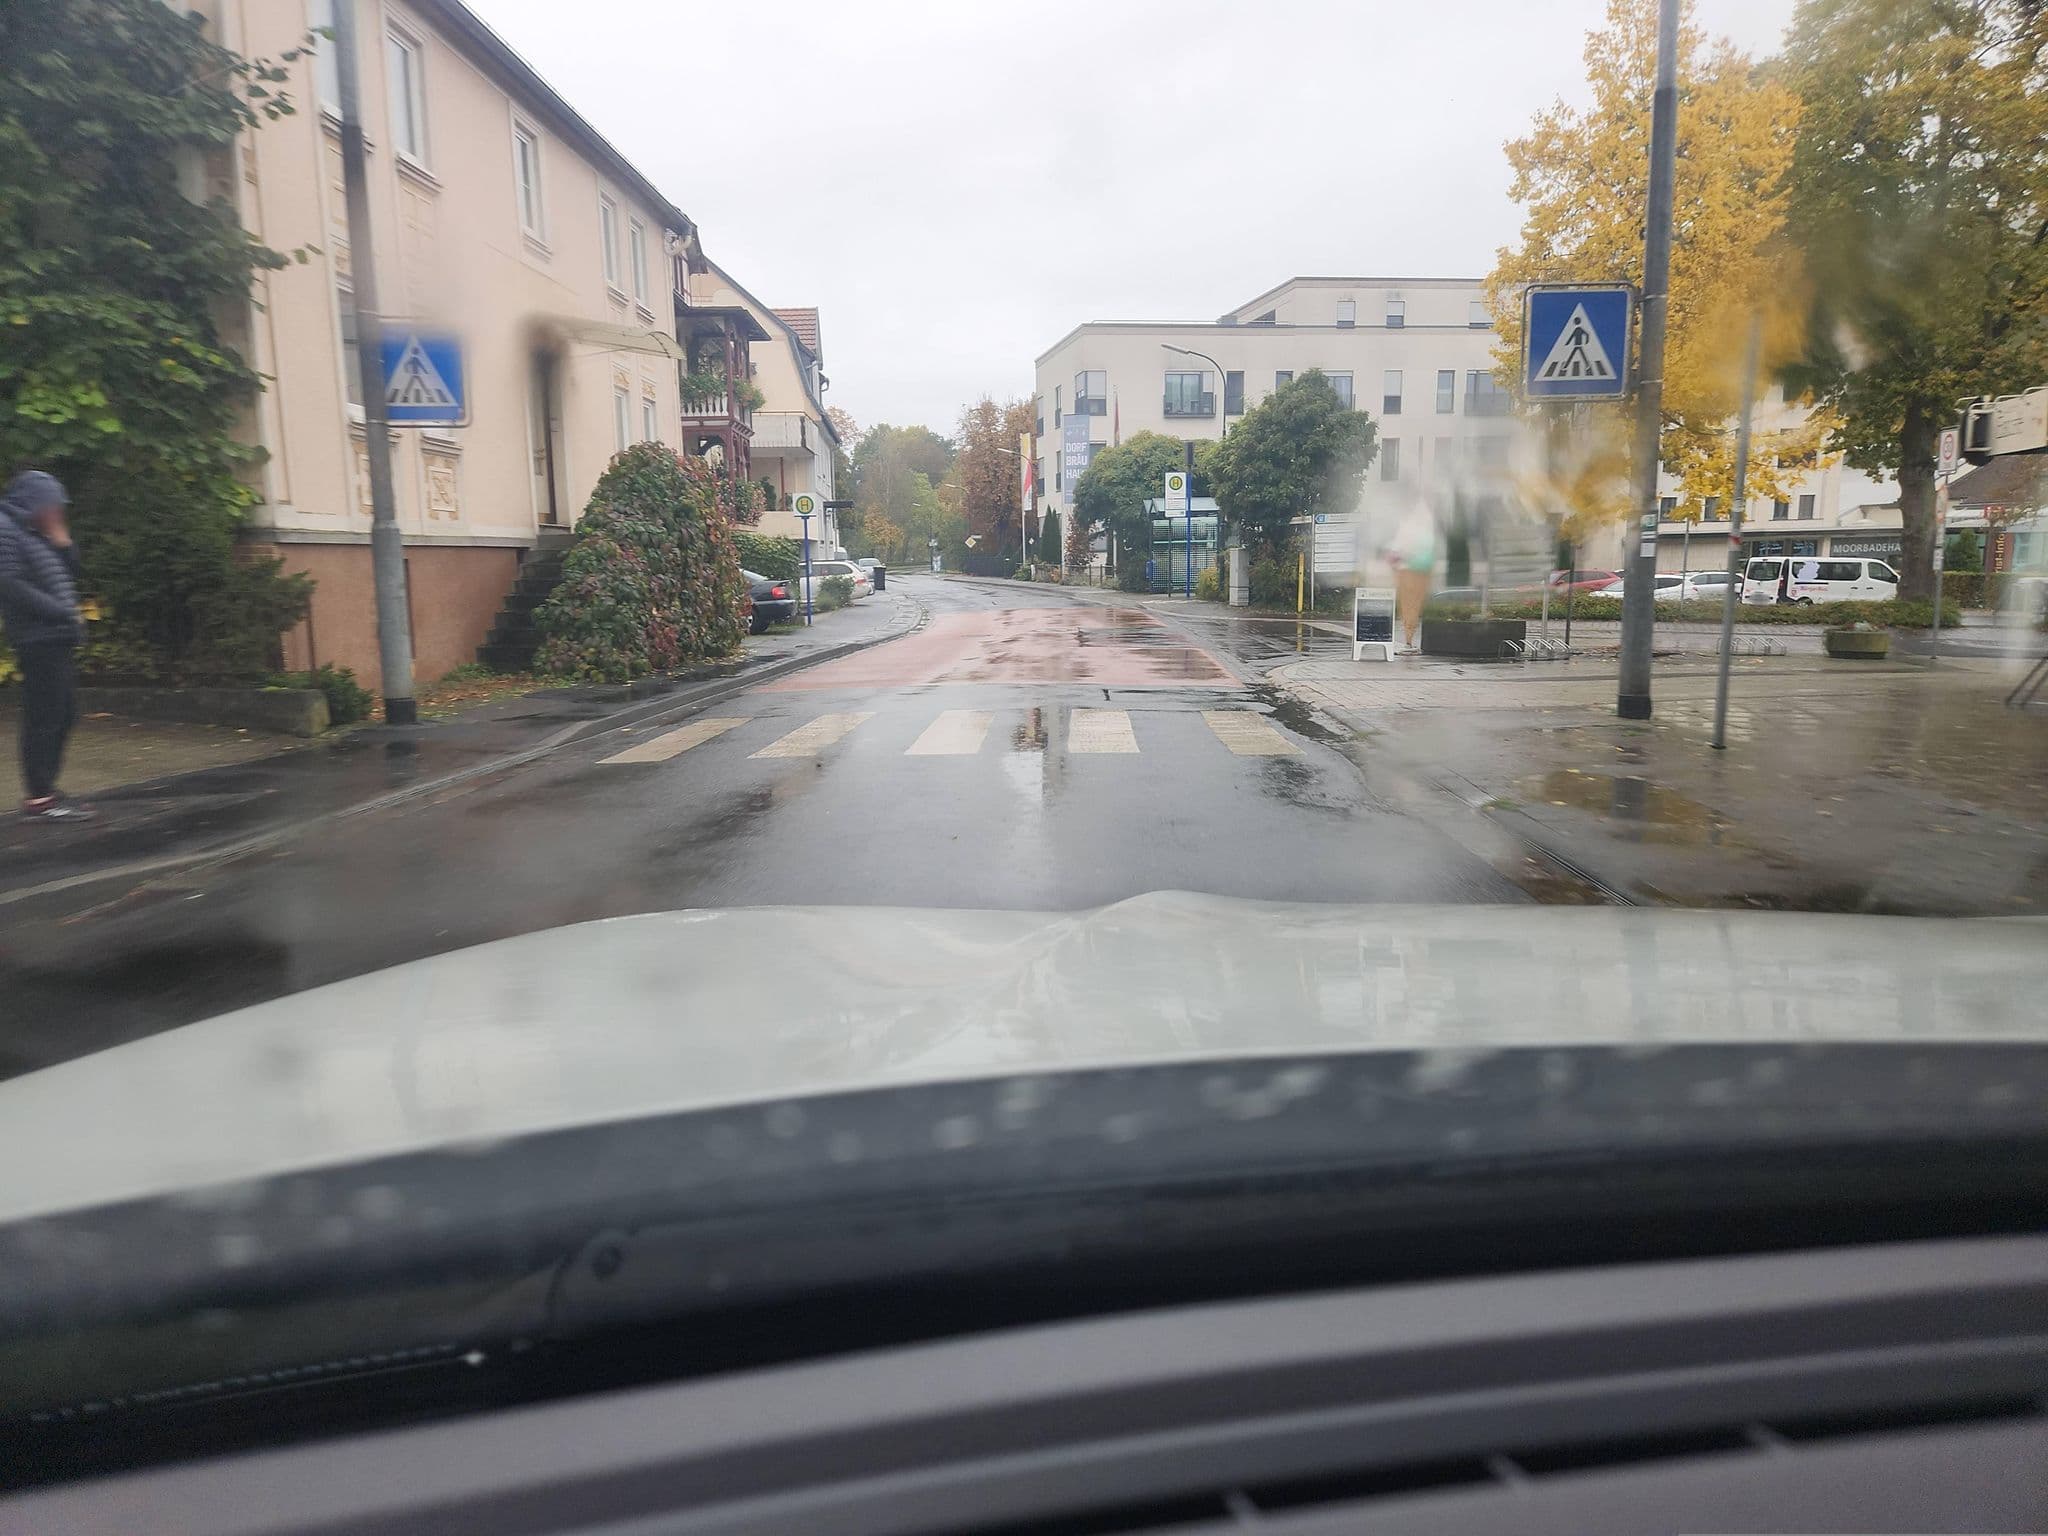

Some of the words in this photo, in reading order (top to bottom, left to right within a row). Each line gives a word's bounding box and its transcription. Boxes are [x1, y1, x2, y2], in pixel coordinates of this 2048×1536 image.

[1065, 442, 1088, 453] DORF
[1065, 453, 1088, 466] BRÄU
[800, 499, 809, 511] H
